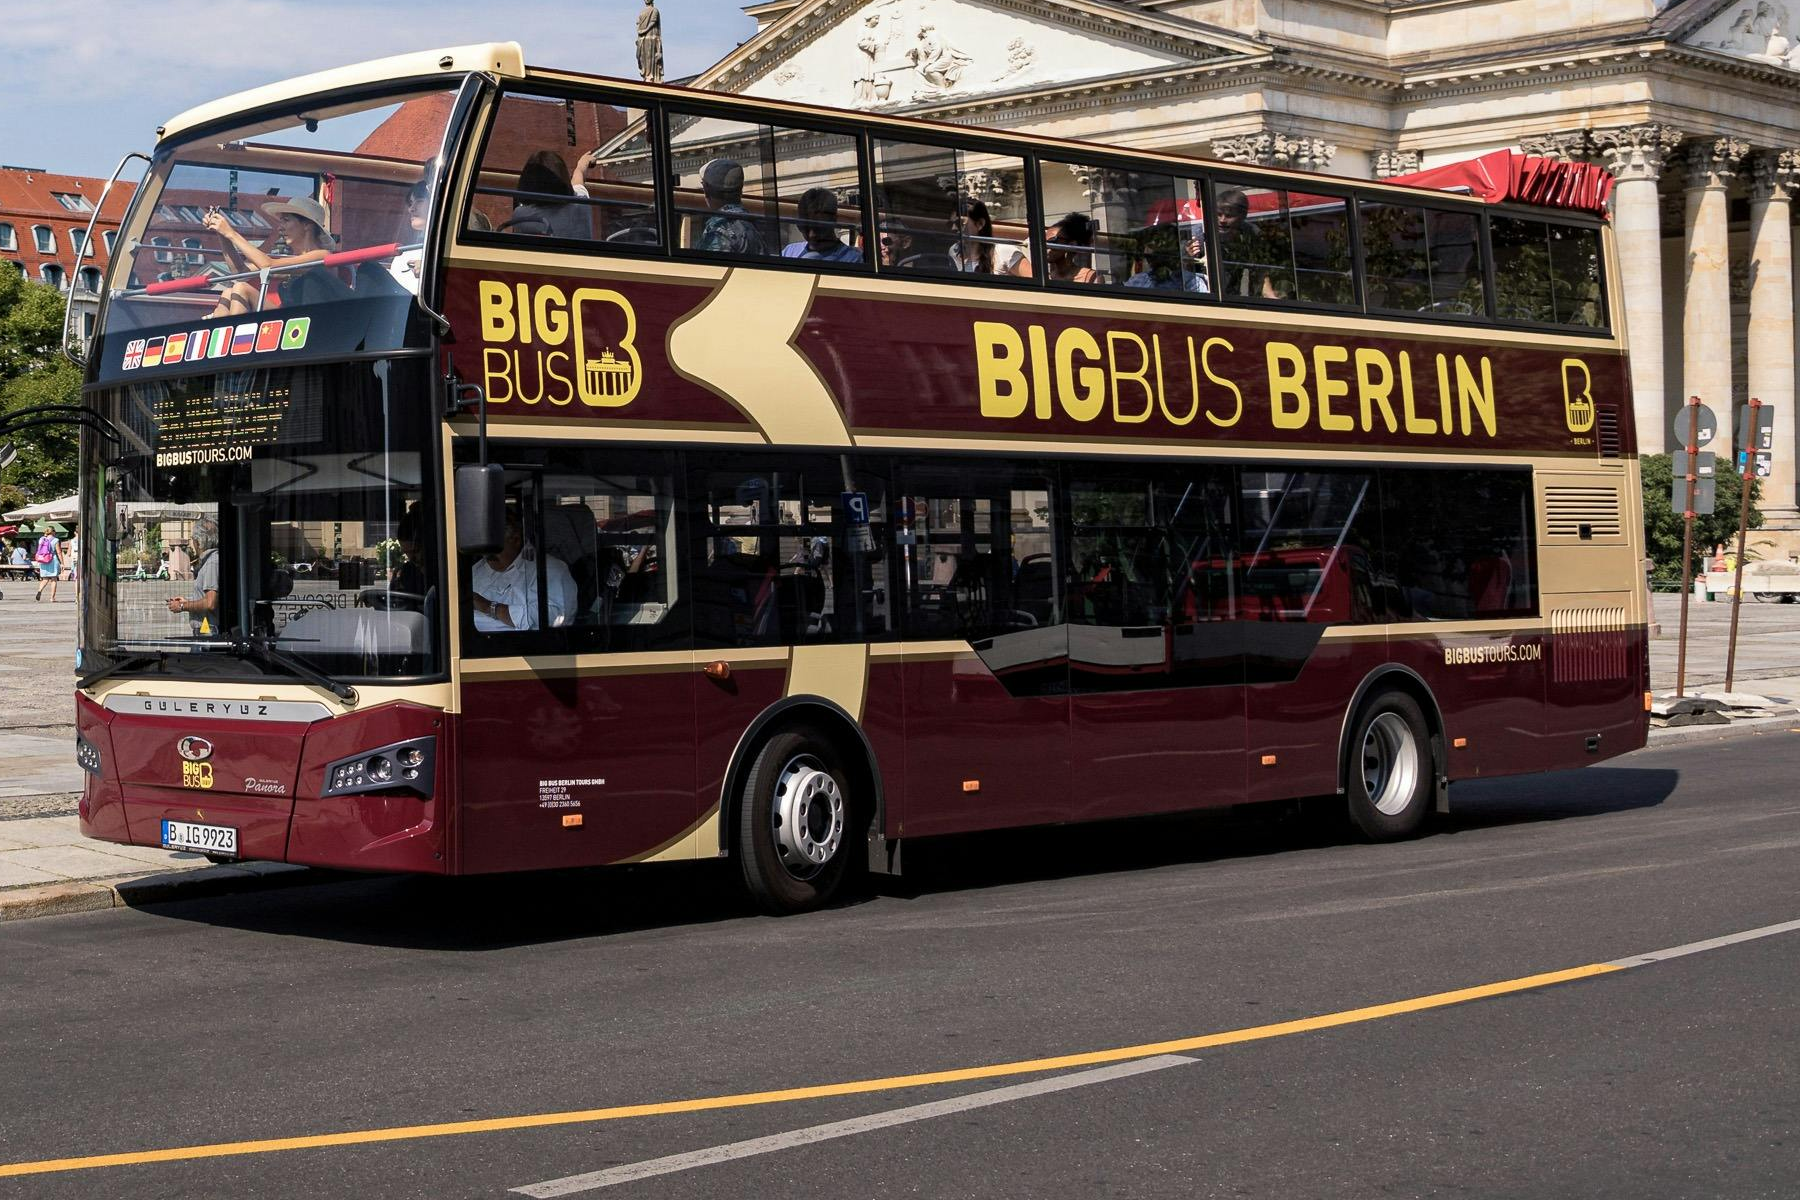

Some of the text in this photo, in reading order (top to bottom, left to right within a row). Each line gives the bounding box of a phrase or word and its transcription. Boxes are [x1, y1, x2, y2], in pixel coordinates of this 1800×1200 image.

[478, 279, 569, 346] BIG
[482, 347, 574, 406] BUS
[1265, 342, 1497, 438] BERLIN
[1573, 437, 1591, 445] BERLIN
[156, 445, 253, 467] BIGBUSTOURS.COM
[1444, 643, 1541, 665] BIGBUSTOURS.COM
[182, 760, 200, 775] BIG
[183, 775, 200, 788] BUS
[244, 777, 286, 794] Panora
[169, 823, 233, 848] B IG 9923
